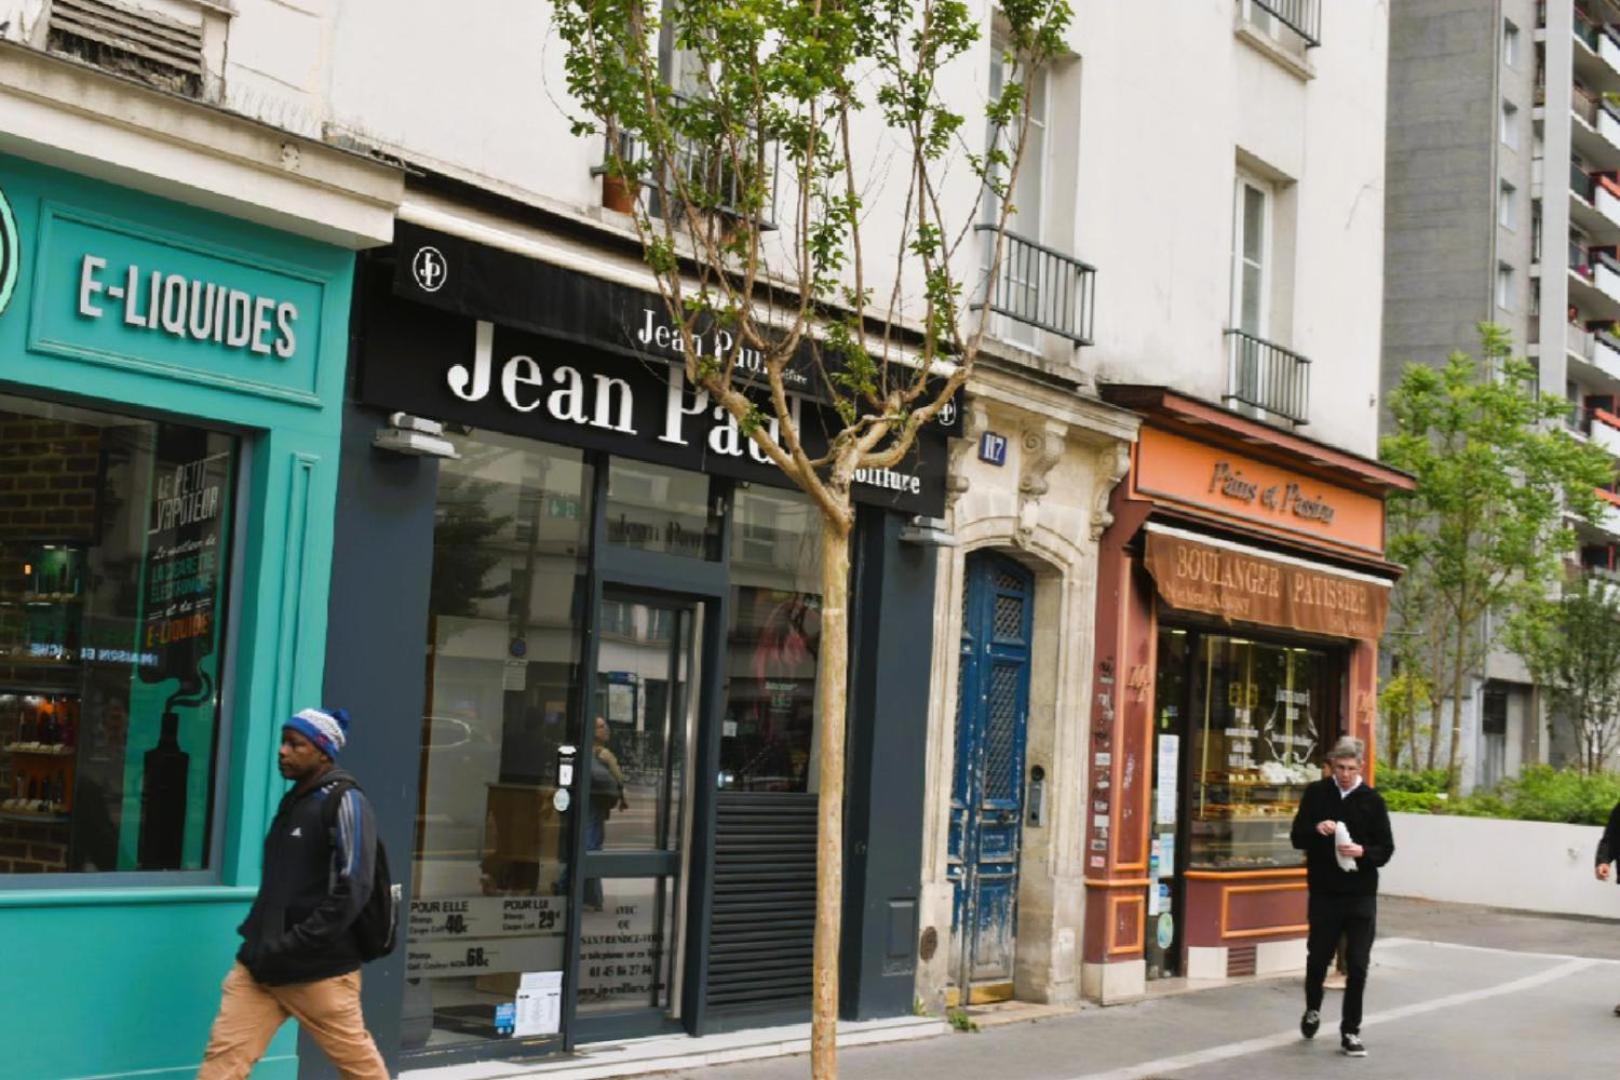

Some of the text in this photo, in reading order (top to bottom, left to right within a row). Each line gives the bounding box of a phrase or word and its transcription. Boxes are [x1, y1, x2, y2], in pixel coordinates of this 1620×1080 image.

[80, 254, 298, 358] E-LIQUIDES
[715, 328, 769, 375] Pau
[447, 320, 638, 435] Jean
[174, 460, 208, 495] PETIT
[1176, 543, 1279, 599] BOULANGER
[1292, 571, 1367, 615] PATISSIER
[411, 901, 469, 912] POUR ELLE
[504, 899, 549, 909] POUR LUI
